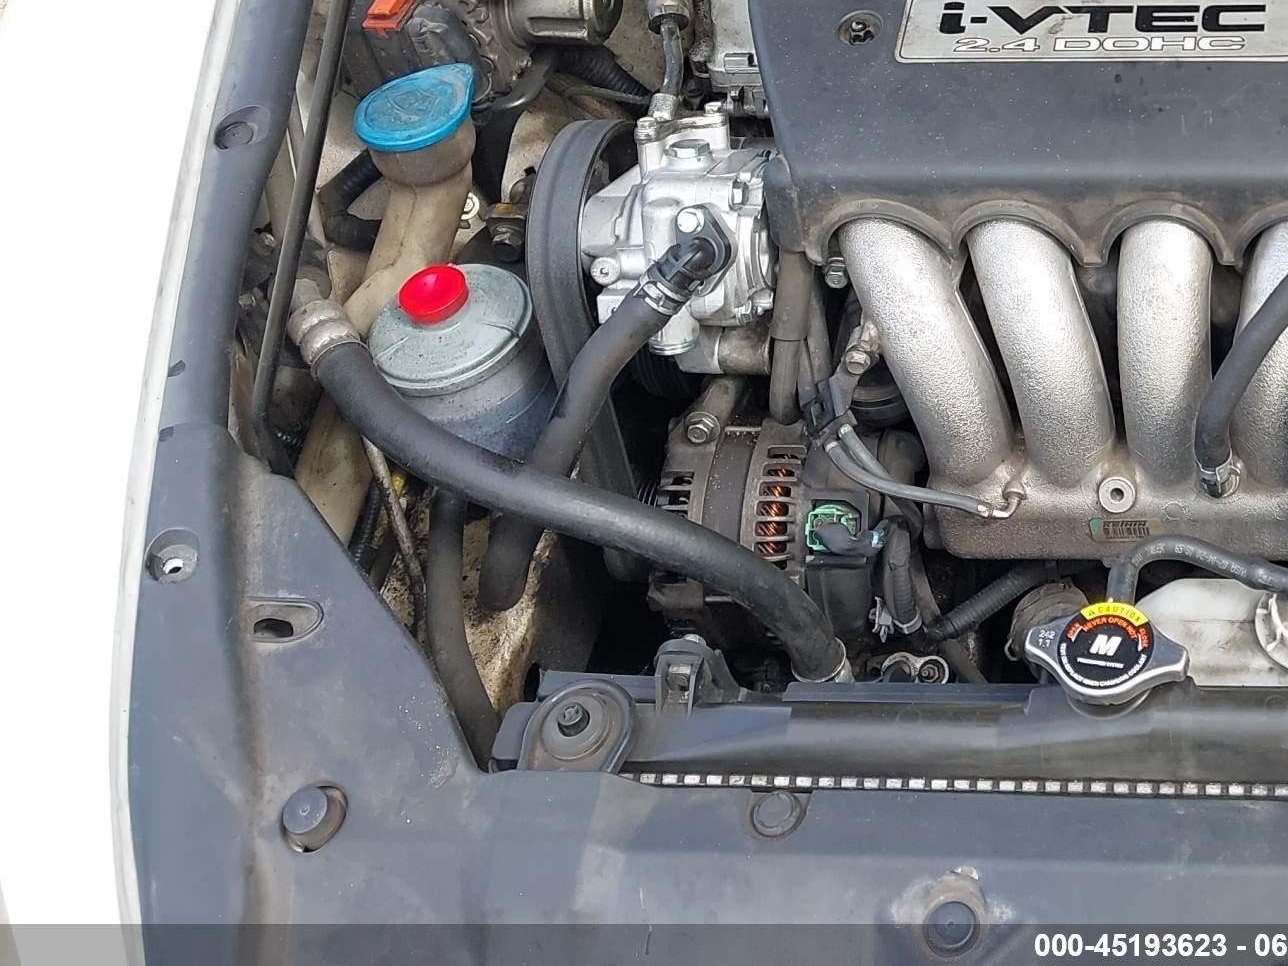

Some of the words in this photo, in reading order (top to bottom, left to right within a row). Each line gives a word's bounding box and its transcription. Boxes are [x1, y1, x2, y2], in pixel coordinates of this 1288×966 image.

[939, 1, 1265, 35] i-VTEC
[953, 36, 1041, 53] 2.4
[1053, 36, 1245, 52] DOHC
[1098, 605, 1143, 623] CAUTION
[1082, 617, 1107, 632] NEVER
[1107, 616, 1128, 629] OPEN
